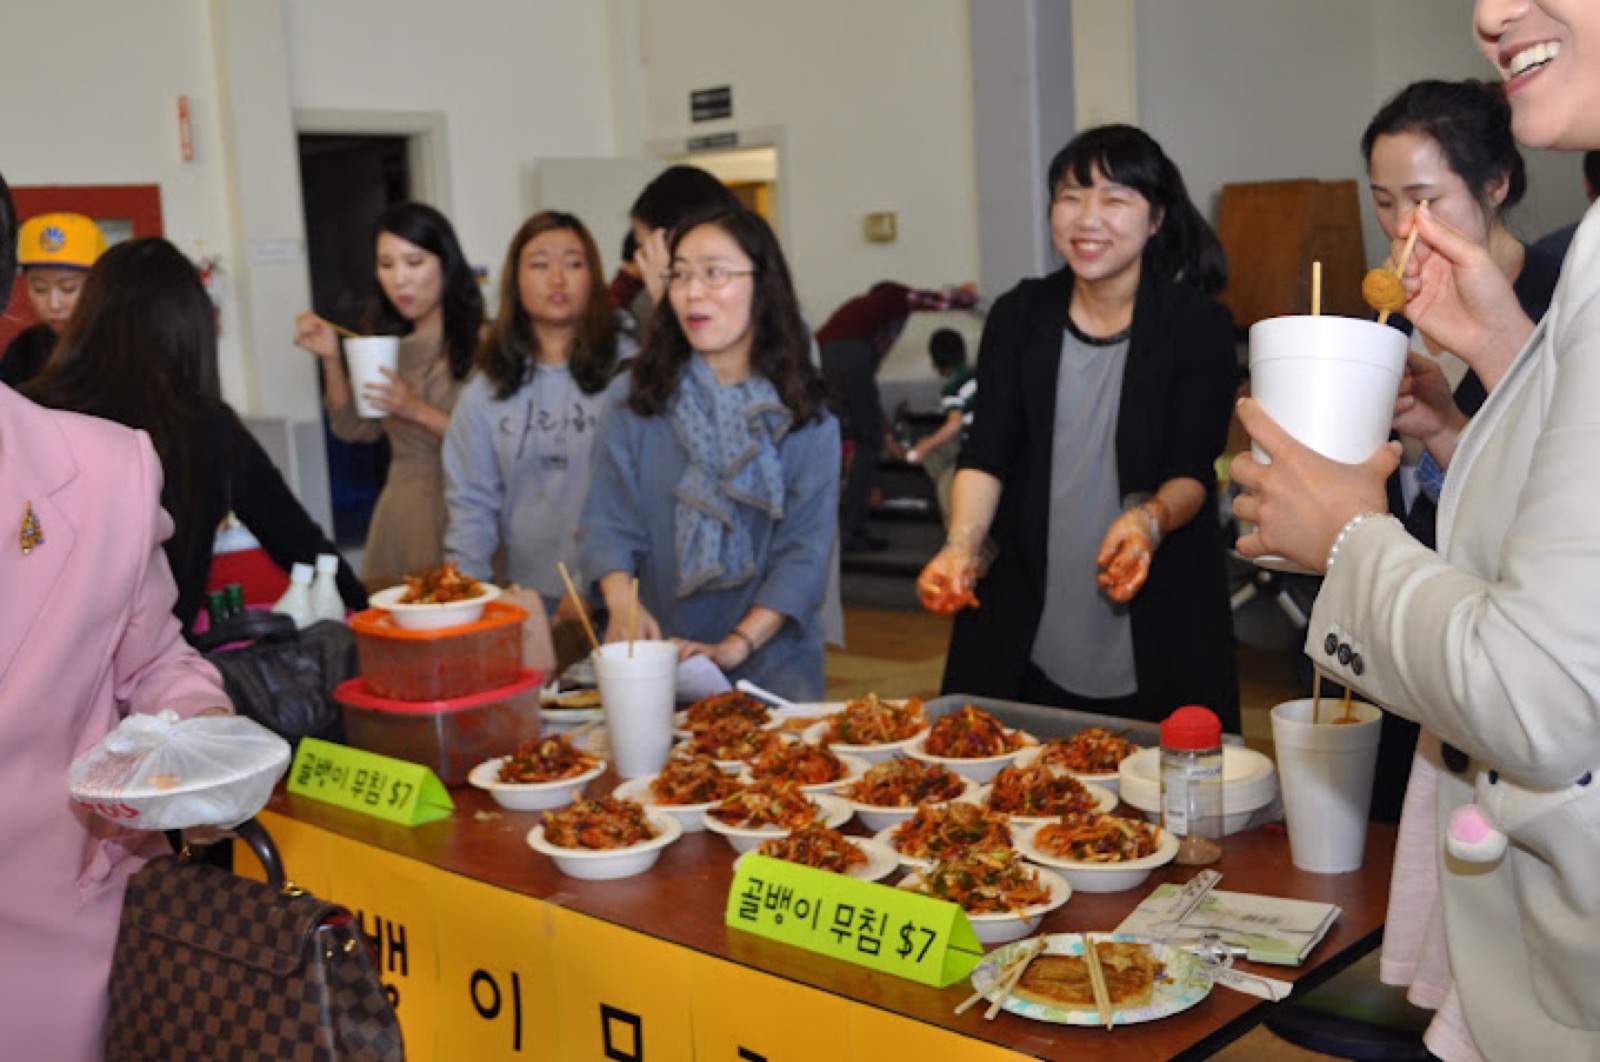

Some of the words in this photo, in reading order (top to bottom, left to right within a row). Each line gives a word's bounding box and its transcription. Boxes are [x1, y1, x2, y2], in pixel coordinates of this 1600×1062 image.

[297, 752, 350, 790] 골뱅이
[351, 768, 389, 805] 무침
[388, 780, 413, 809] $7
[739, 877, 823, 931] 골뱅이
[829, 903, 889, 956] 무침
[896, 920, 937, 963] $7
